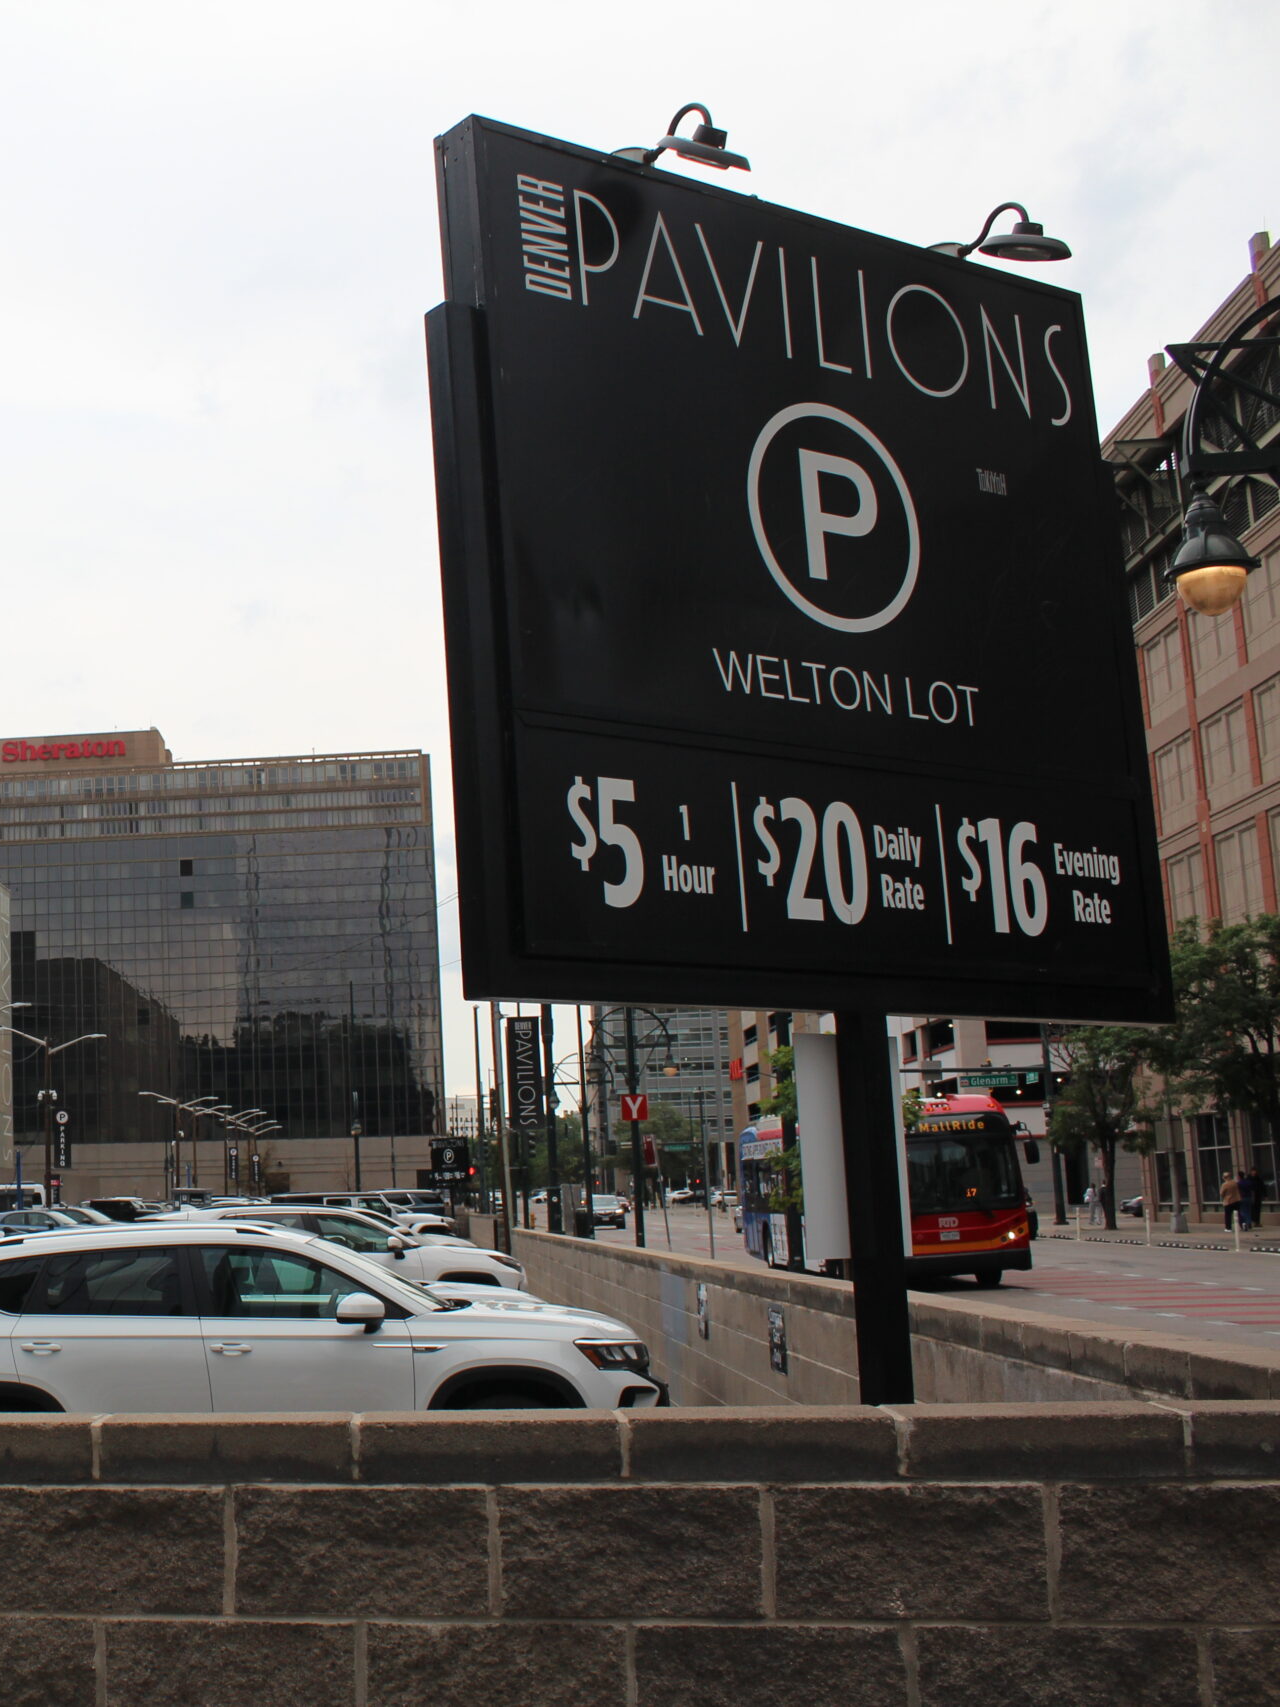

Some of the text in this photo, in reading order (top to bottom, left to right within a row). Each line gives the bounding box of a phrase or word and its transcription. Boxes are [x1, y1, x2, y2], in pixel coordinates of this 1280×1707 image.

[517, 174, 572, 300] DENVER
[573, 188, 1072, 427] PAVILIONS
[798, 447, 878, 581] P
[713, 648, 978, 726] WELTON LOT
[1, 738, 126, 763] Sheraton
[567, 775, 645, 908] $5
[678, 805, 691, 841] 1
[753, 796, 869, 925] $20
[873, 824, 922, 868] Daily
[1053, 842, 1121, 885] Evening
[661, 855, 716, 895] Hour
[880, 873, 925, 911] Rate
[957, 817, 1048, 937] $16
[1072, 890, 1112, 924] Rate
[514, 1030, 538, 1125] PAVILIONS
[970, 1075, 1009, 1086] Glenarm
[918, 1120, 985, 1132] MallRide
